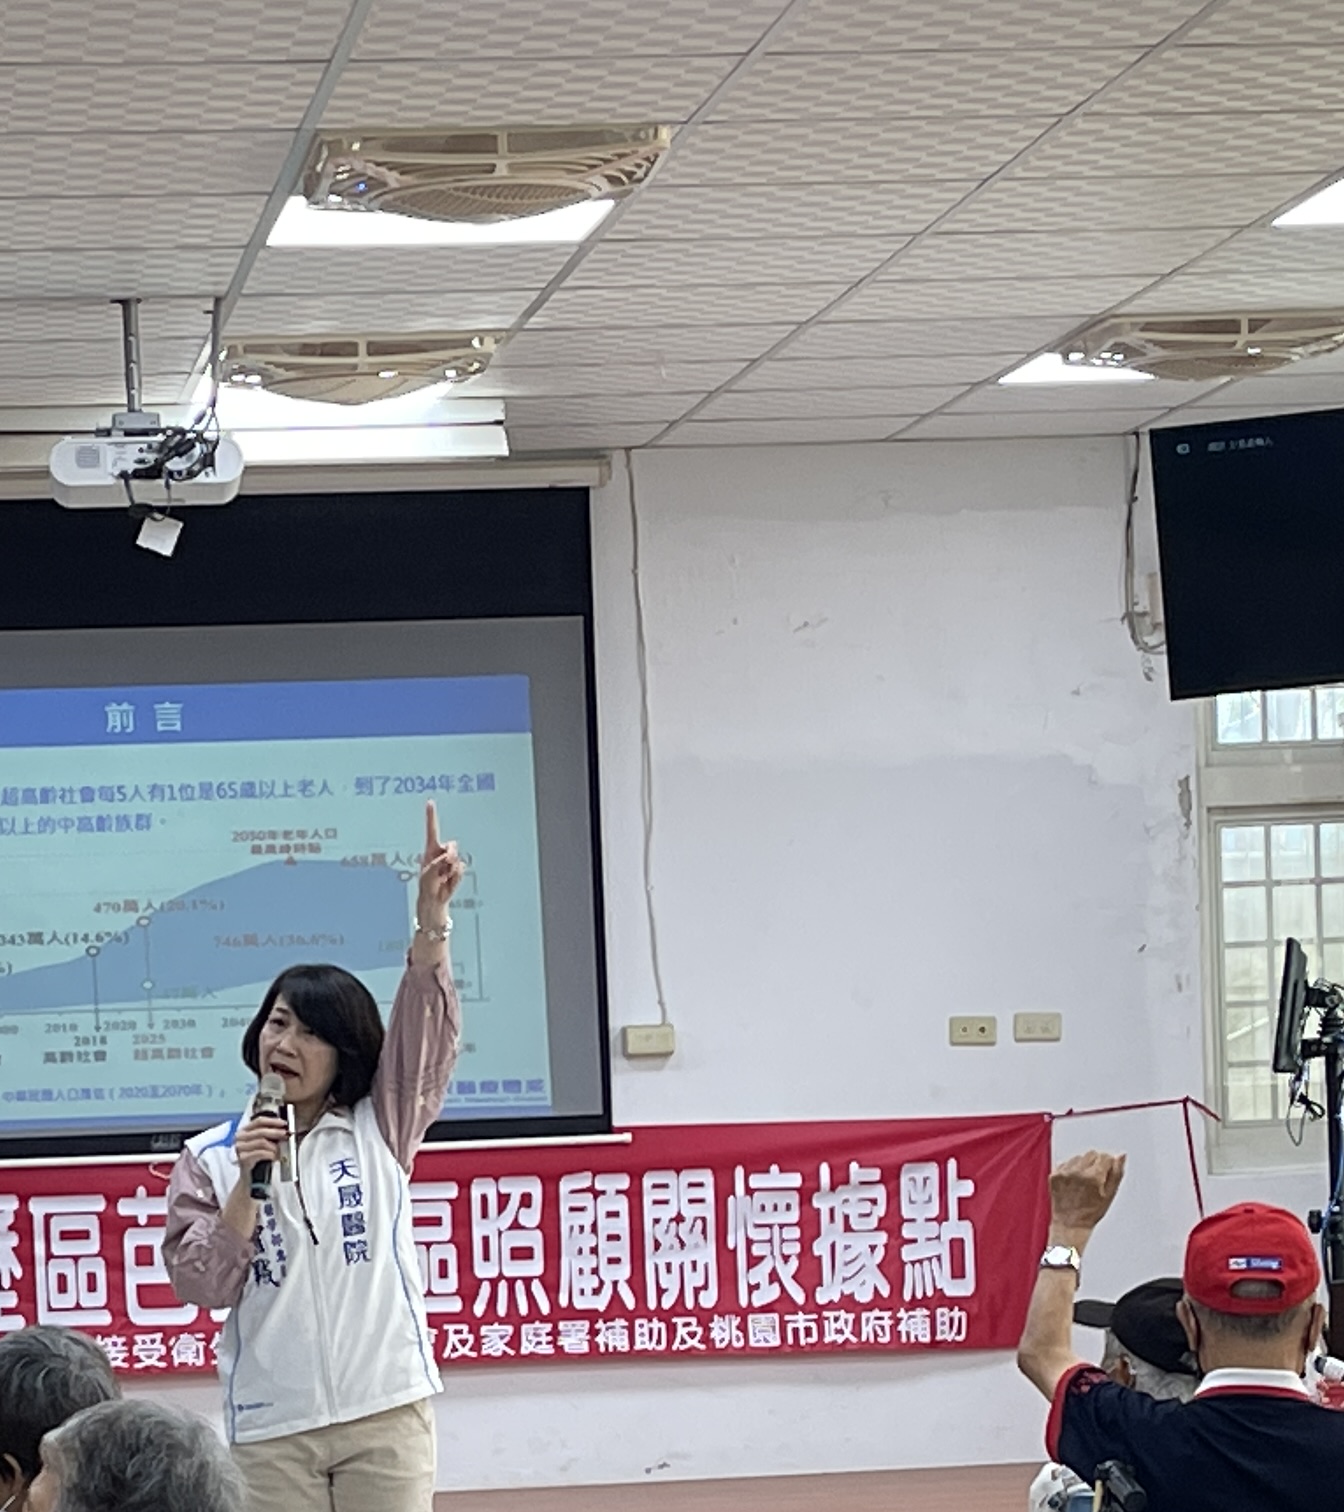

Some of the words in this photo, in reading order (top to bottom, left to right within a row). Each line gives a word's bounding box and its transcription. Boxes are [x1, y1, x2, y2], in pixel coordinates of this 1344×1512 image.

[105, 701, 184, 734] 前言
[44, 1022, 78, 1034] 2010
[102, 1020, 137, 1032] 2020
[162, 1018, 197, 1029] 2030
[221, 1017, 253, 1028] 204
